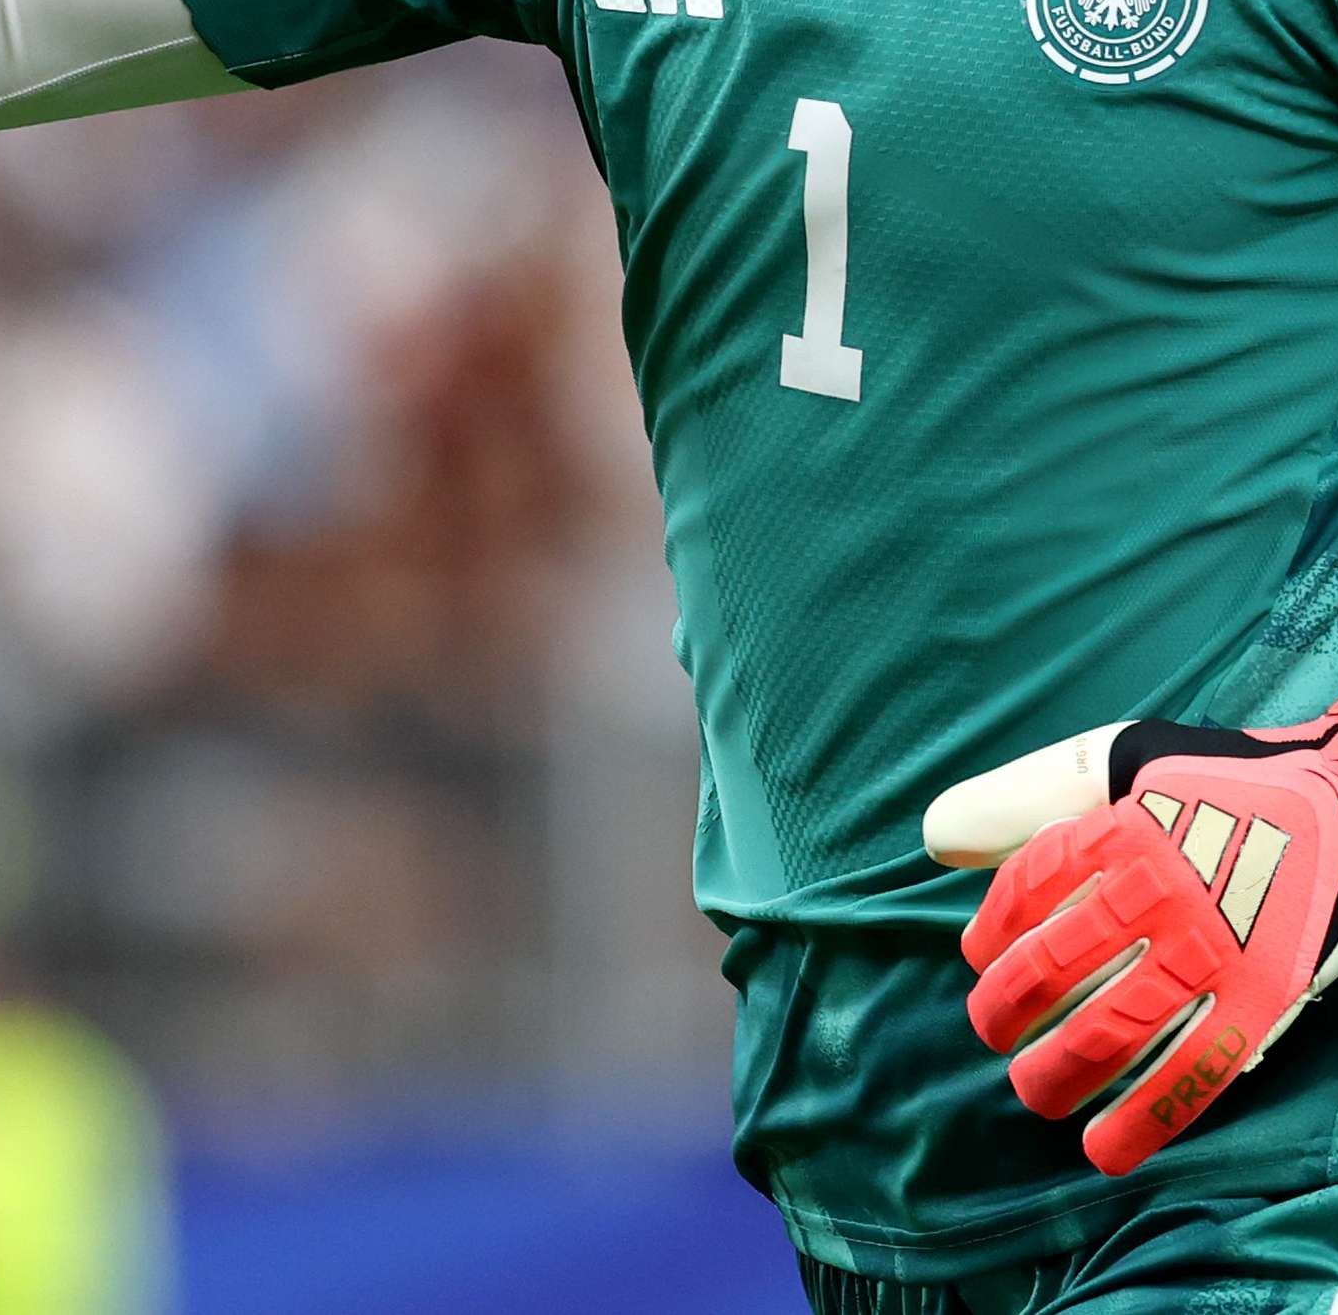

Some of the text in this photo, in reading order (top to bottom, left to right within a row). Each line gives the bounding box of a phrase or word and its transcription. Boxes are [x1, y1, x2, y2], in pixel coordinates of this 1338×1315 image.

[1051, 6, 1175, 59] FUSSBALL-BUND
[780, 97, 863, 402] 1
[1150, 1025, 1247, 1128] PRED
